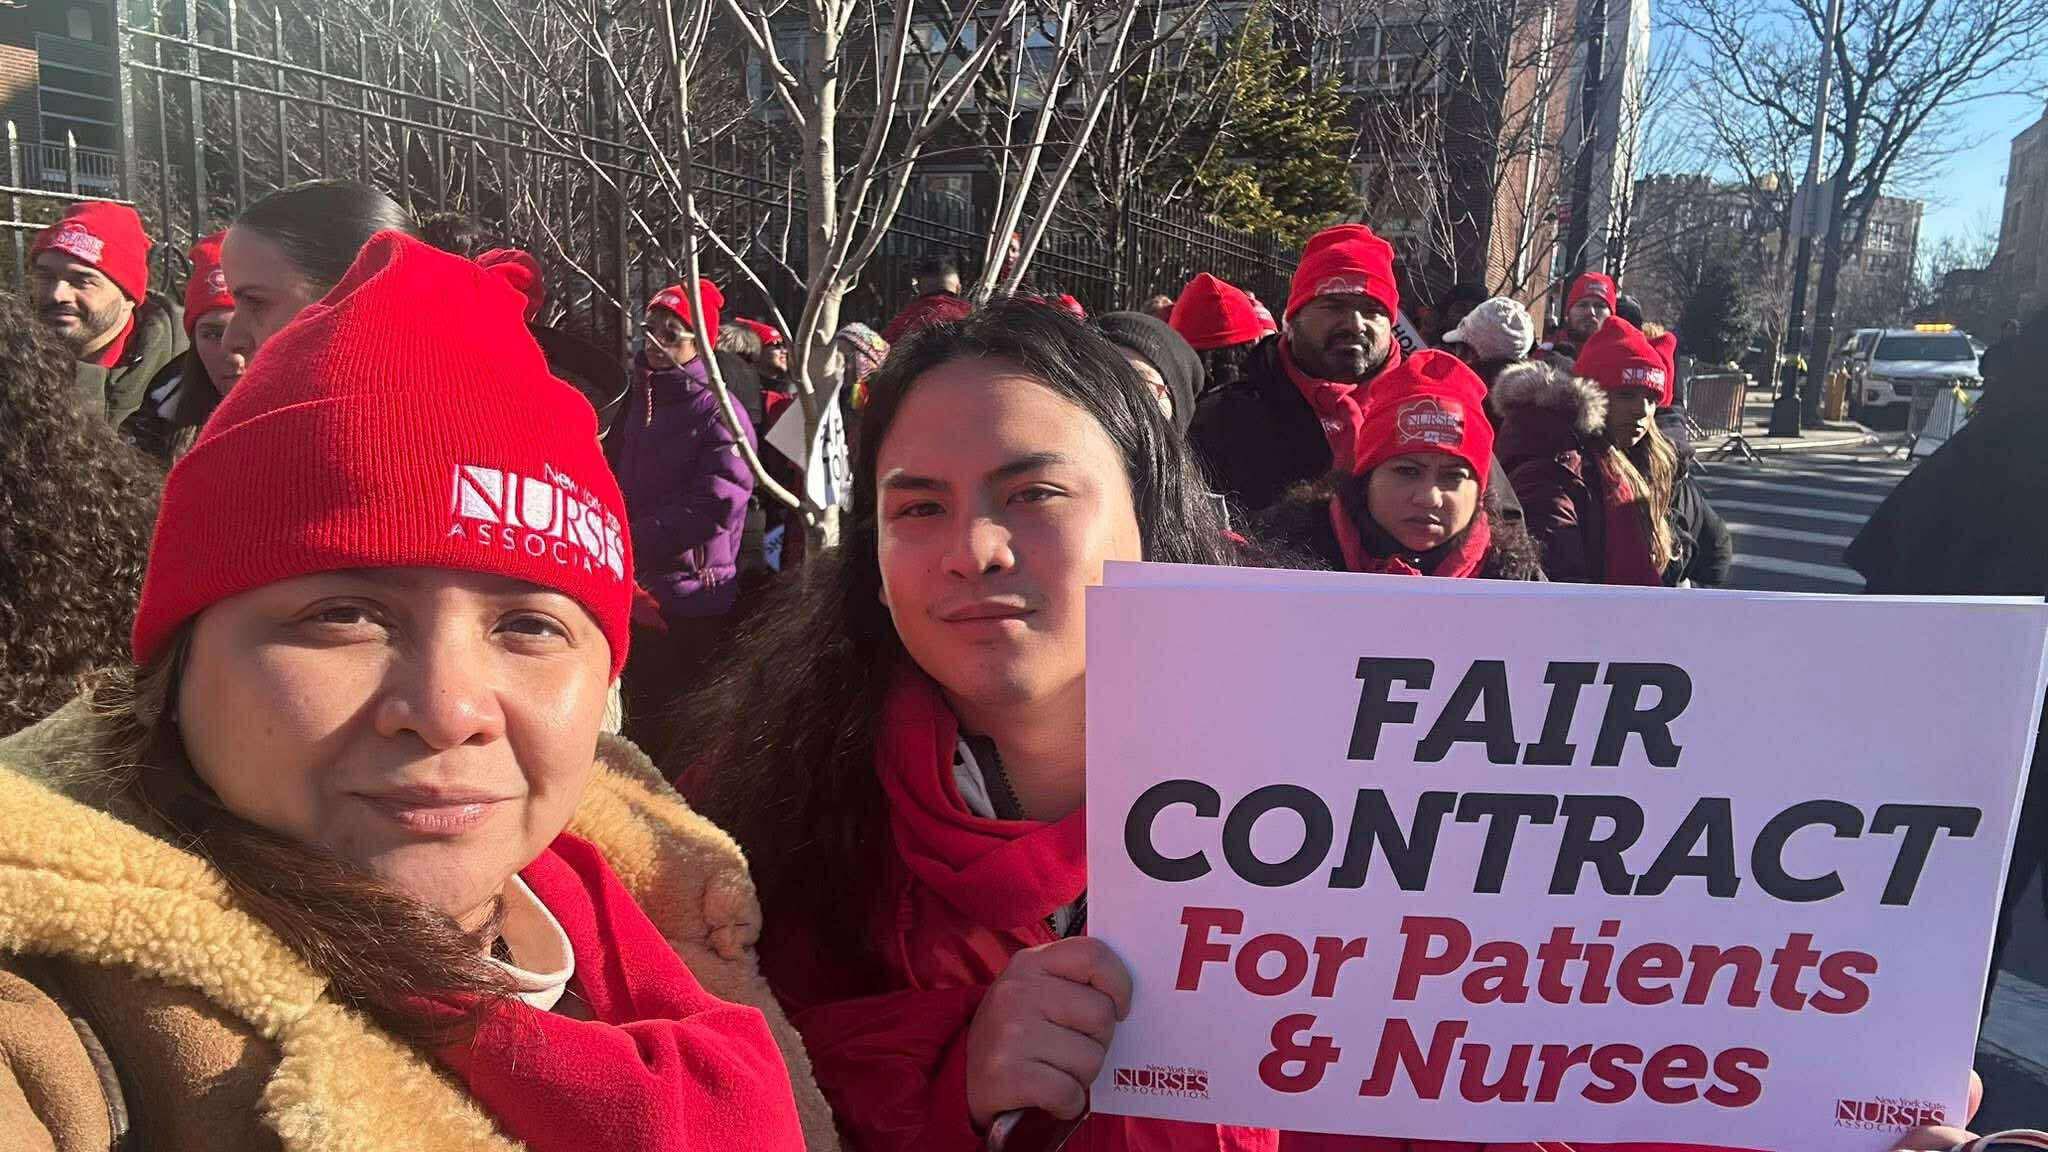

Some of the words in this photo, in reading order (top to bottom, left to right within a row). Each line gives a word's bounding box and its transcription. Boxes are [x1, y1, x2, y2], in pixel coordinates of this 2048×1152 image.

[544, 463, 579, 493] New
[452, 464, 625, 581] NURSES
[1347, 656, 1693, 768] FAIR
[1124, 779, 1982, 905] CONTRACT
[1175, 906, 1367, 998] For
[1392, 915, 1878, 1015] Patients
[1146, 1063, 1166, 1072] New
[1167, 1064, 1186, 1074] York
[1258, 1013, 1342, 1094] &
[1360, 1018, 1770, 1108] Nurses
[1113, 1086, 1210, 1100] ASSOCIATION
[1114, 1068, 1209, 1092] NURSES
[1835, 1098, 1945, 1127] NURSES
[1874, 1095, 1897, 1106] New
[1898, 1097, 1920, 1107] York
